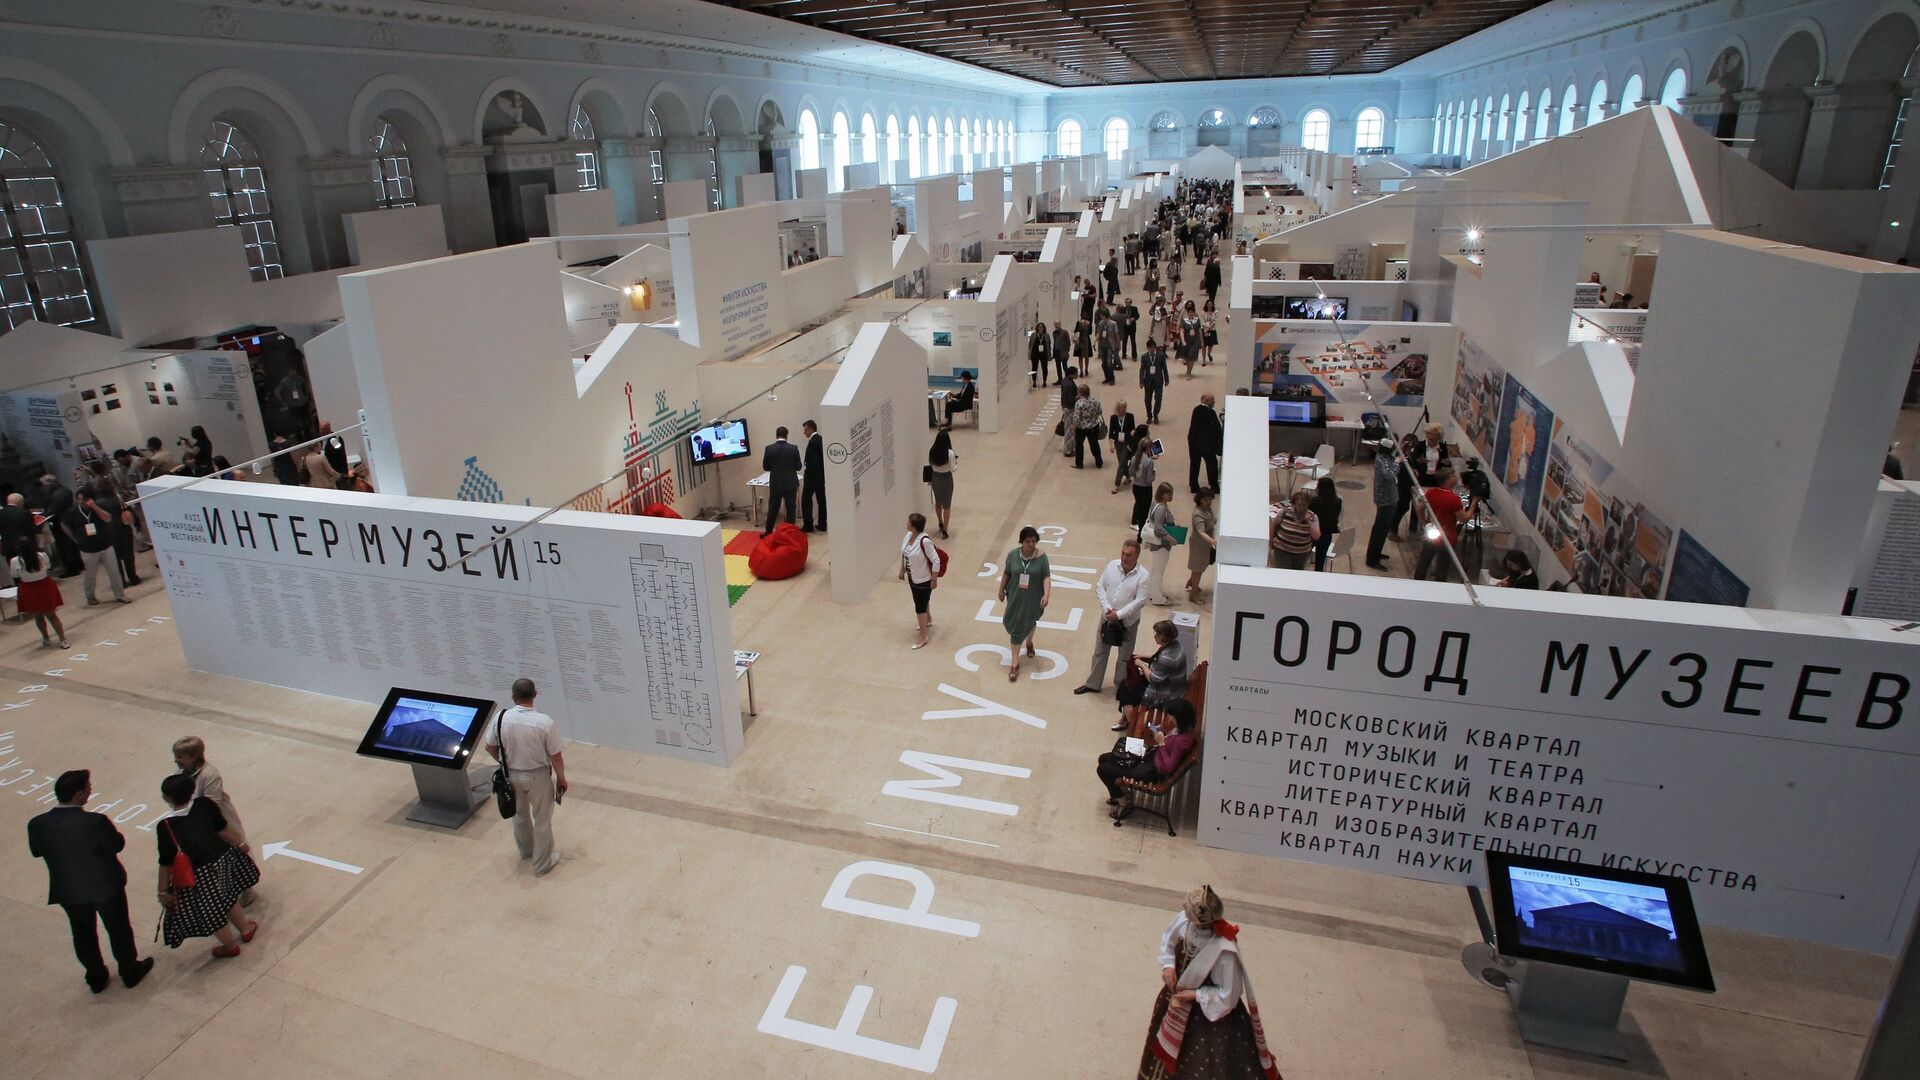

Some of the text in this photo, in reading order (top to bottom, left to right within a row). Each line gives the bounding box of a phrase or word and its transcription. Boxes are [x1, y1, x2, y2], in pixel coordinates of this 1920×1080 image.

[829, 449, 845, 457] ВДНХ
[152, 520, 203, 532] МЕЖДУНАРОДНЫЙ
[170, 532, 207, 543] ФЕСТИВАЛЬ
[202, 506, 562, 581] ИНТЕР МУЗЕЙ 15
[1229, 685, 1270, 695] КВАРТАЛЫ
[1232, 611, 1911, 730] ГОРОД МУЗЕЕВ
[1227, 726, 1584, 785] КВАРТАЛ МУЗЫКИ И ТЕАТРА
[1294, 708, 1581, 757] МОСКОВСКИЙ КВАРТАЛ
[1288, 759, 1603, 815] ИСТОРИЧЕСКИЙ КВАРТАЛ
[1285, 784, 1597, 841] ЛИТЕРАТУРНЫЙ КВАРТАЛ
[1220, 799, 1318, 827] КВАРТАЛ
[1601, 852, 1757, 892] ИСКУССТВА
[1280, 831, 1473, 874] КВАРТАЛ НАУКИ
[1568, 876, 1581, 887] 15
